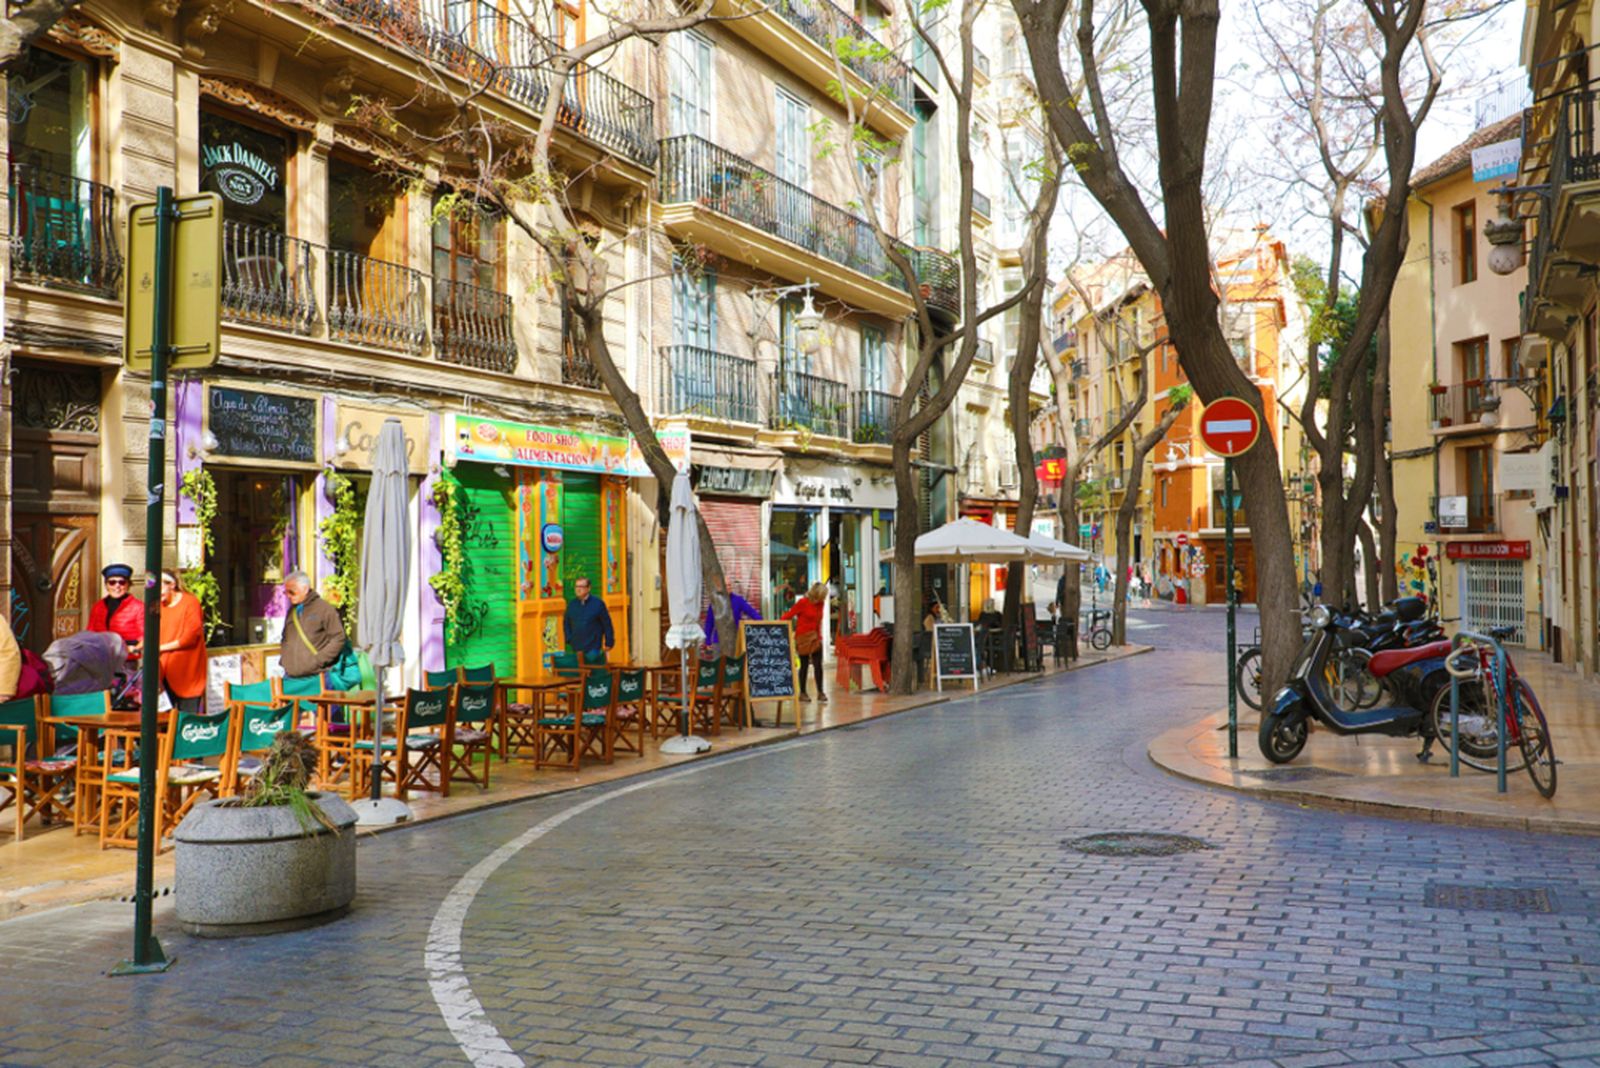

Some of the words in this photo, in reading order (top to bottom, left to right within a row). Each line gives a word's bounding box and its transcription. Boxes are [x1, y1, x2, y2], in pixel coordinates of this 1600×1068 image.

[203, 144, 232, 168] JACK
[526, 430, 553, 442] FOOD
[554, 432, 579, 447] SHOP
[660, 437, 688, 449] SHOP
[181, 722, 220, 743] Carlsberg
[248, 717, 286, 735] Carlsberg
